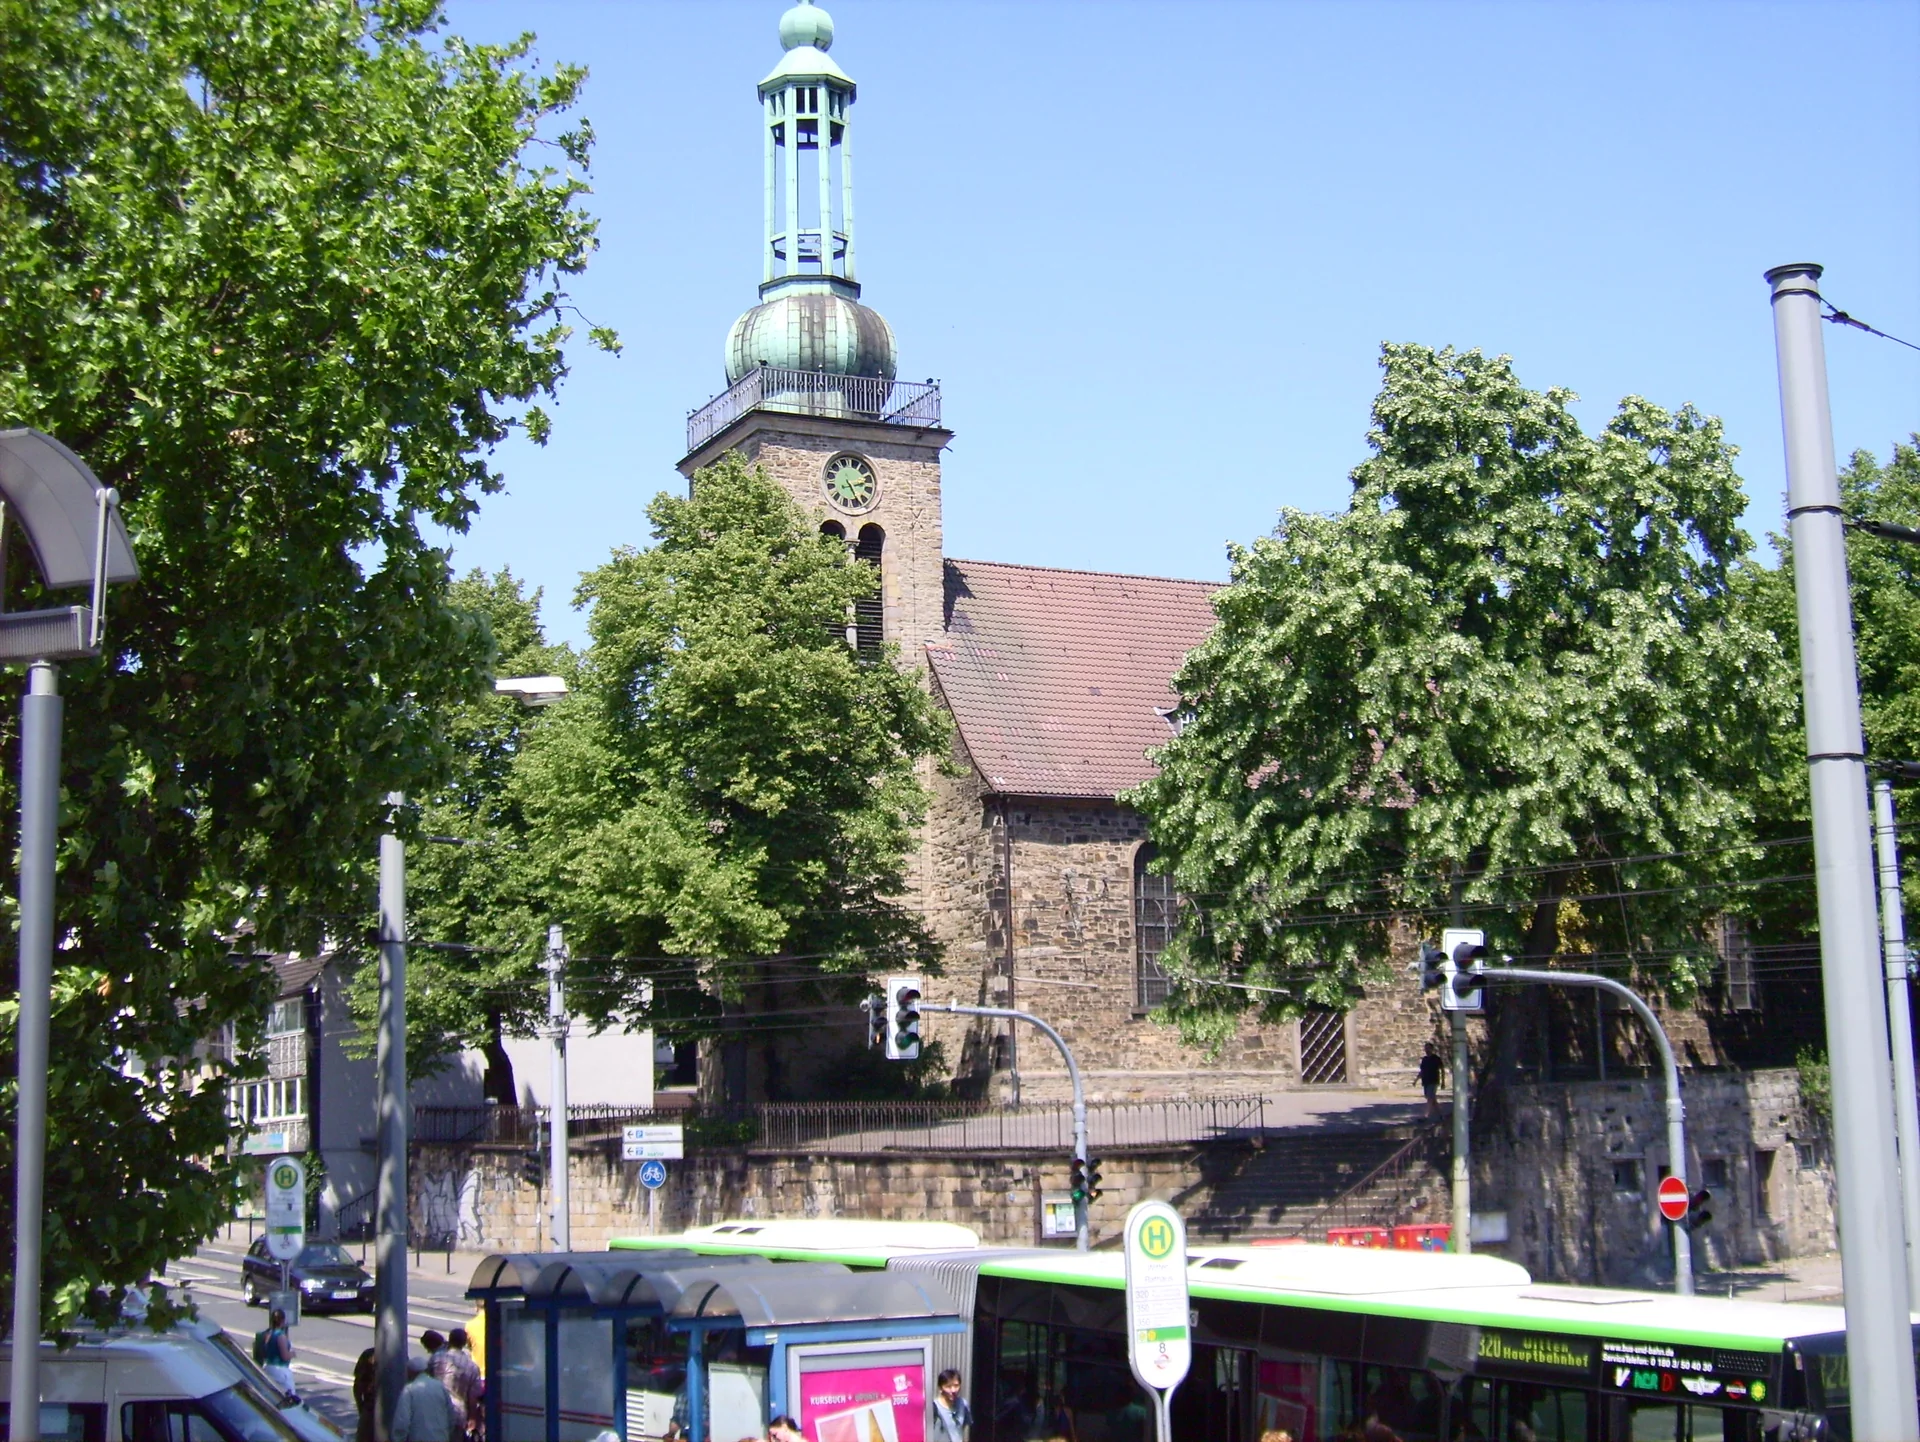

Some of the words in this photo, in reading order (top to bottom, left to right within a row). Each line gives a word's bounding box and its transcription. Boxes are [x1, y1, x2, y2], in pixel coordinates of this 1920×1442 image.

[1148, 1225, 1166, 1250] H
[1159, 1343, 1166, 1353] 8
[1478, 1334, 1502, 1358] 320
[1503, 1347, 1589, 1368] Hauptbahnhof
[1680, 1359, 1690, 1370] 50
[1691, 1360, 1701, 1371] 40
[1702, 1361, 1713, 1372] 30
[810, 1394, 846, 1405] KURSBUCH
[893, 1396, 909, 1406] 2006
